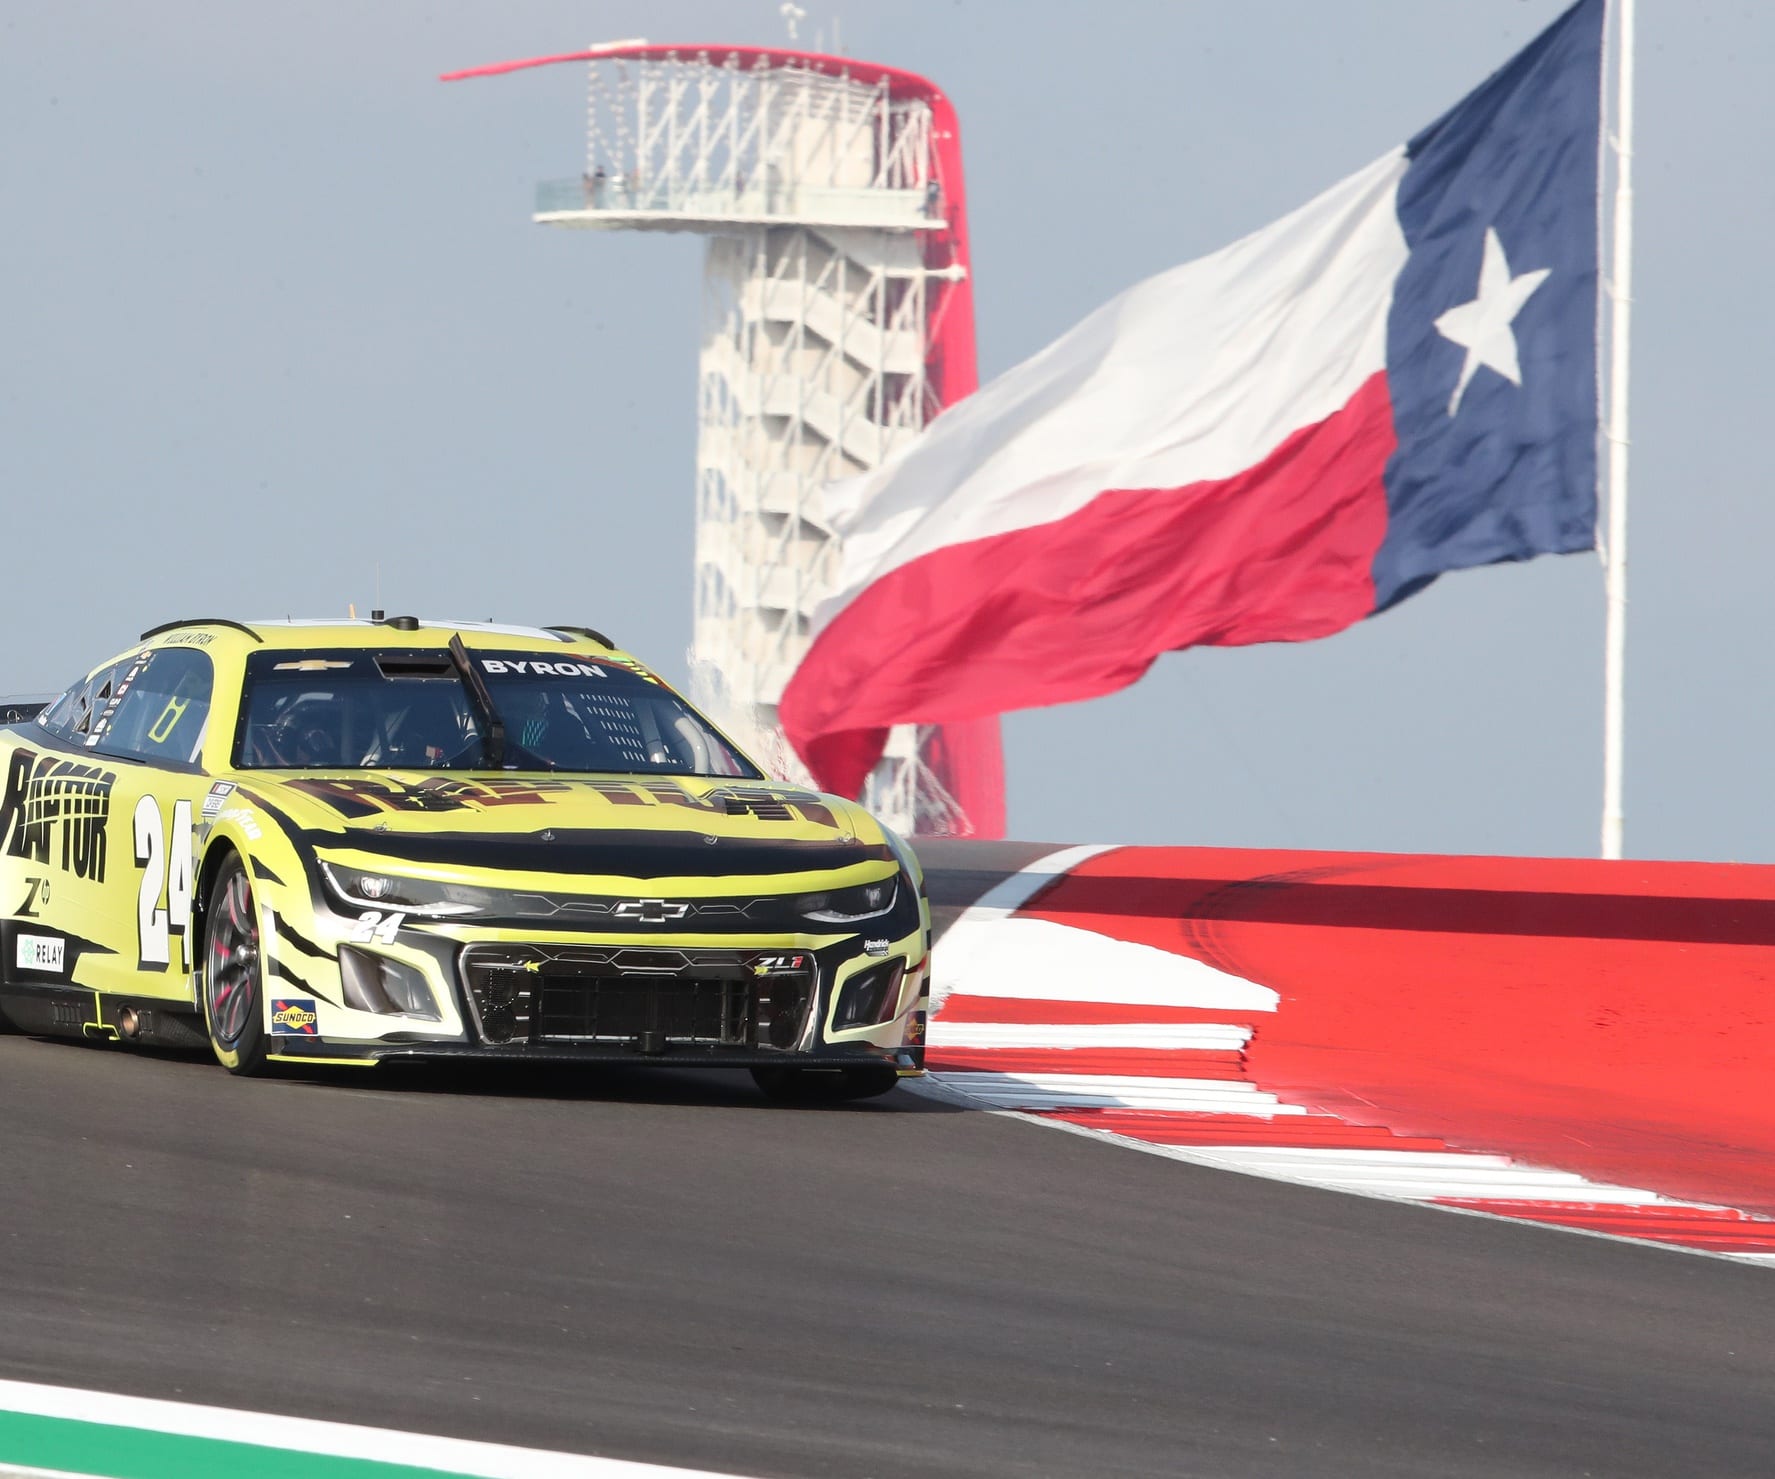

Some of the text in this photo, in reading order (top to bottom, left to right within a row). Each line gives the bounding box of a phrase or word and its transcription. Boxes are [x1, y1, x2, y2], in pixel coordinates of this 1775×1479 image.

[481, 659, 609, 678] BYRON
[0, 747, 117, 884] RAPTOR
[133, 794, 192, 974] 24
[350, 911, 406, 945] 24
[36, 944, 62, 965] RELAY
[864, 939, 889, 951] Hendrick
[757, 956, 804, 969] ZL1
[275, 1013, 314, 1022] SUNOCO
